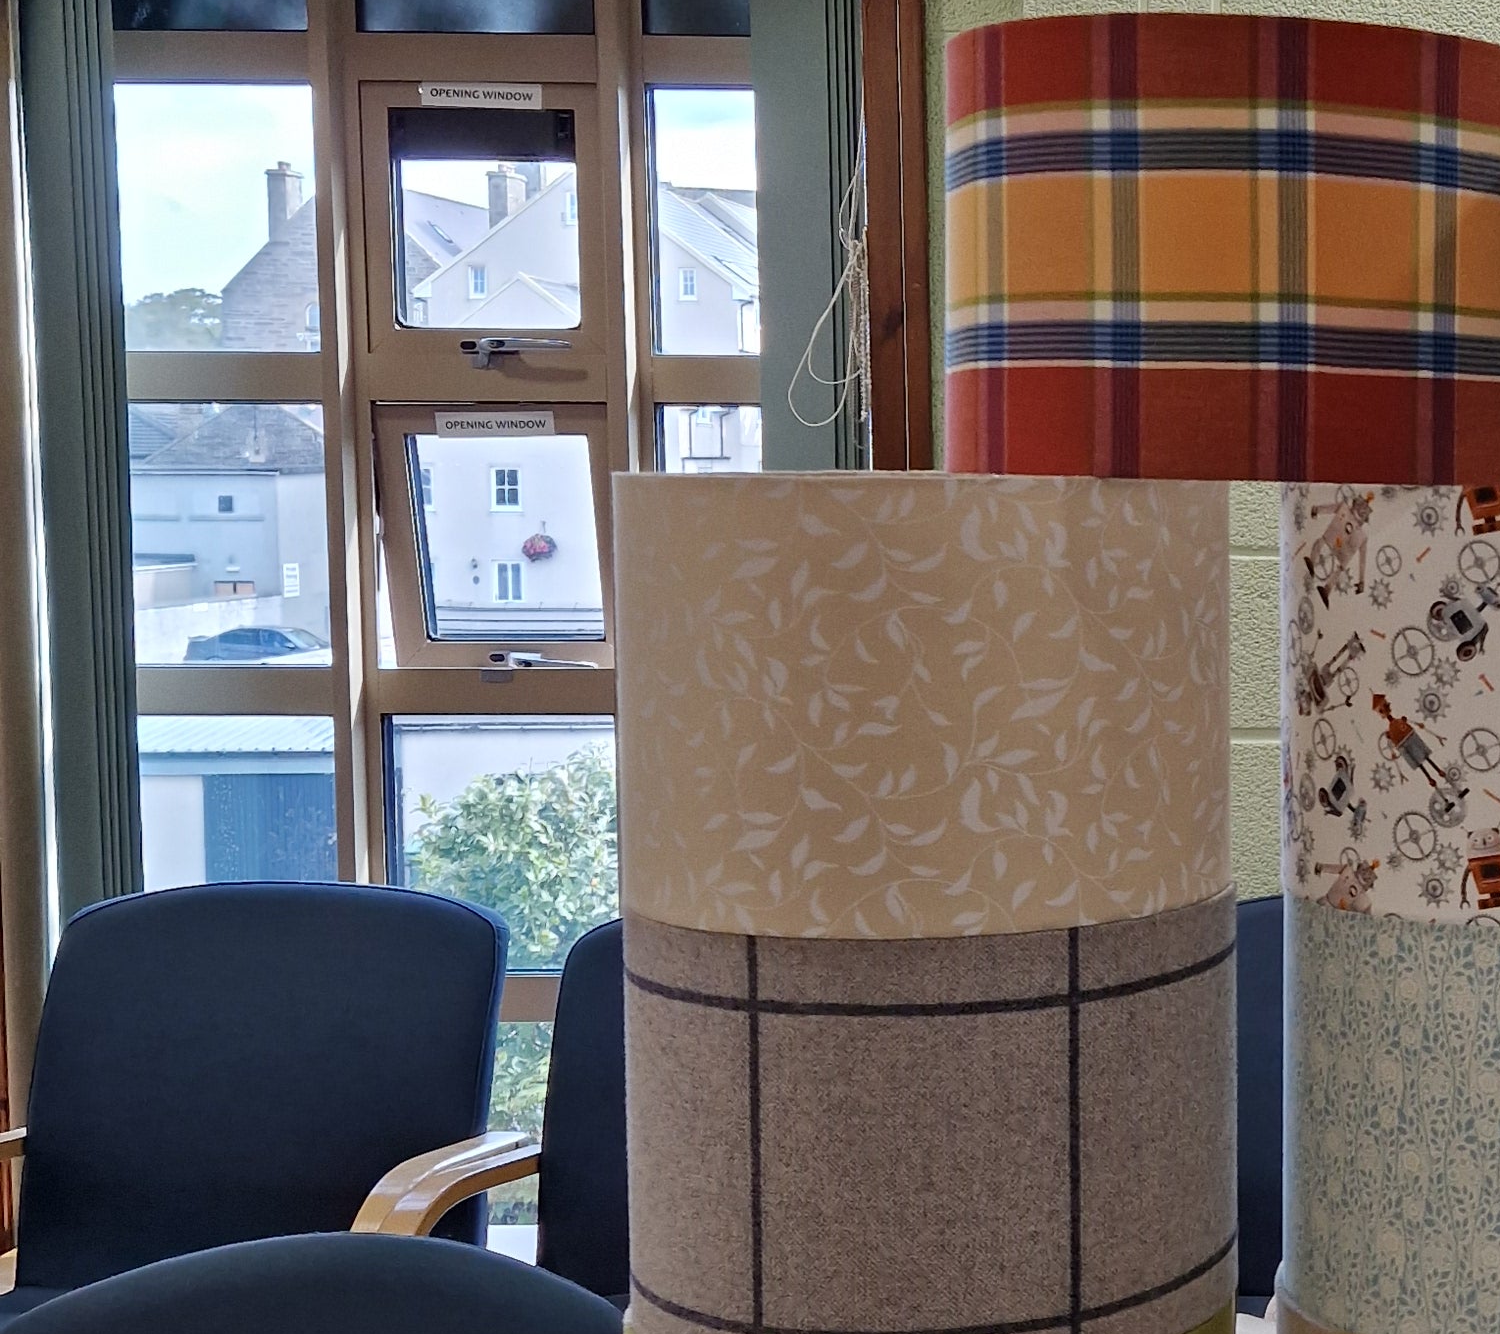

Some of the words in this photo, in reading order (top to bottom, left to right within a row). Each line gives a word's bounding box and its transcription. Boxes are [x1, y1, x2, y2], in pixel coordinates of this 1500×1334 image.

[430, 88, 480, 99] OPENING
[483, 91, 533, 101] WINDOW
[445, 420, 492, 429] OPENING
[495, 420, 546, 429] WINDOW
